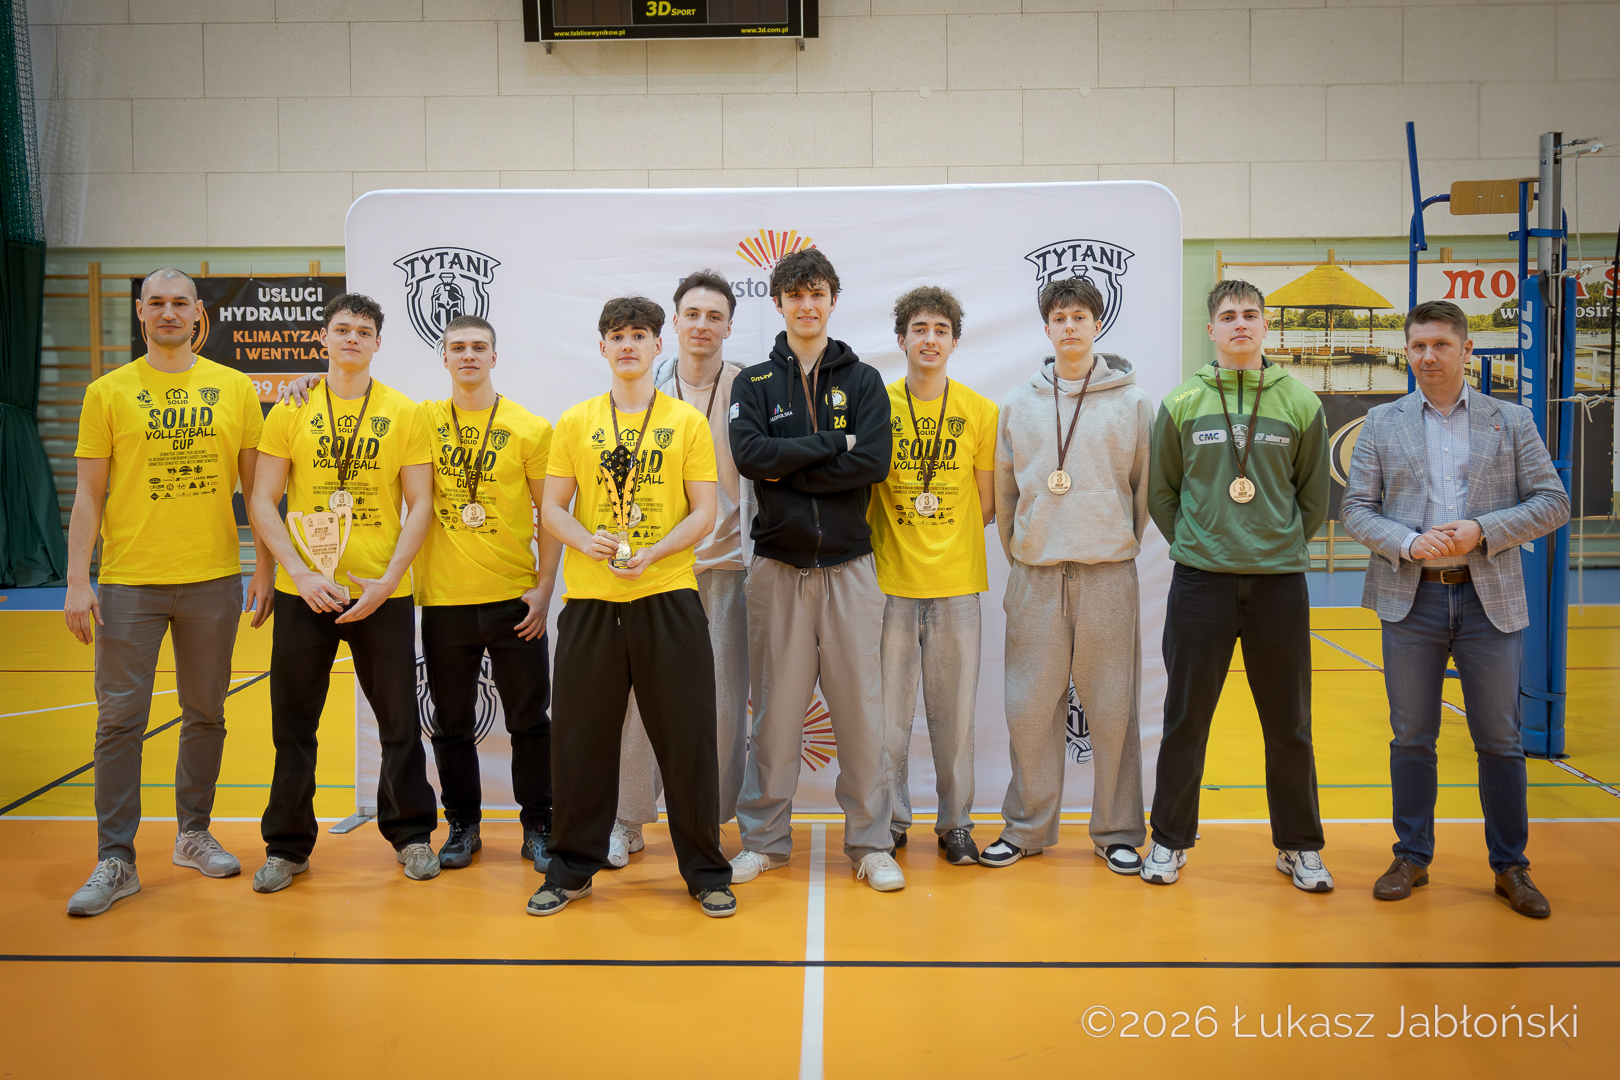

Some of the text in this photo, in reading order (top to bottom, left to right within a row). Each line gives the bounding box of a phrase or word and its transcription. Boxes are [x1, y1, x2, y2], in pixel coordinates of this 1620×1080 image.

[645, 1, 671, 16] 3D
[553, 29, 626, 37] www.tablicewynikow.pl
[741, 26, 789, 34] www.3d.com.pl
[403, 252, 488, 279] TYTANI
[1035, 244, 1122, 274] TYTANI
[258, 286, 323, 302] USŁUGI
[219, 306, 325, 321] HYDRAULIC
[233, 330, 321, 343] KLIMATYZA
[235, 347, 330, 360] I WENTYLAC
[1173, 386, 1201, 404] Kempa
[148, 407, 213, 430] SOLID
[833, 415, 847, 429] 26
[145, 427, 217, 440] VOLLEYBALL
[1198, 432, 1220, 441] CMC
[173, 438, 194, 450] CUP
